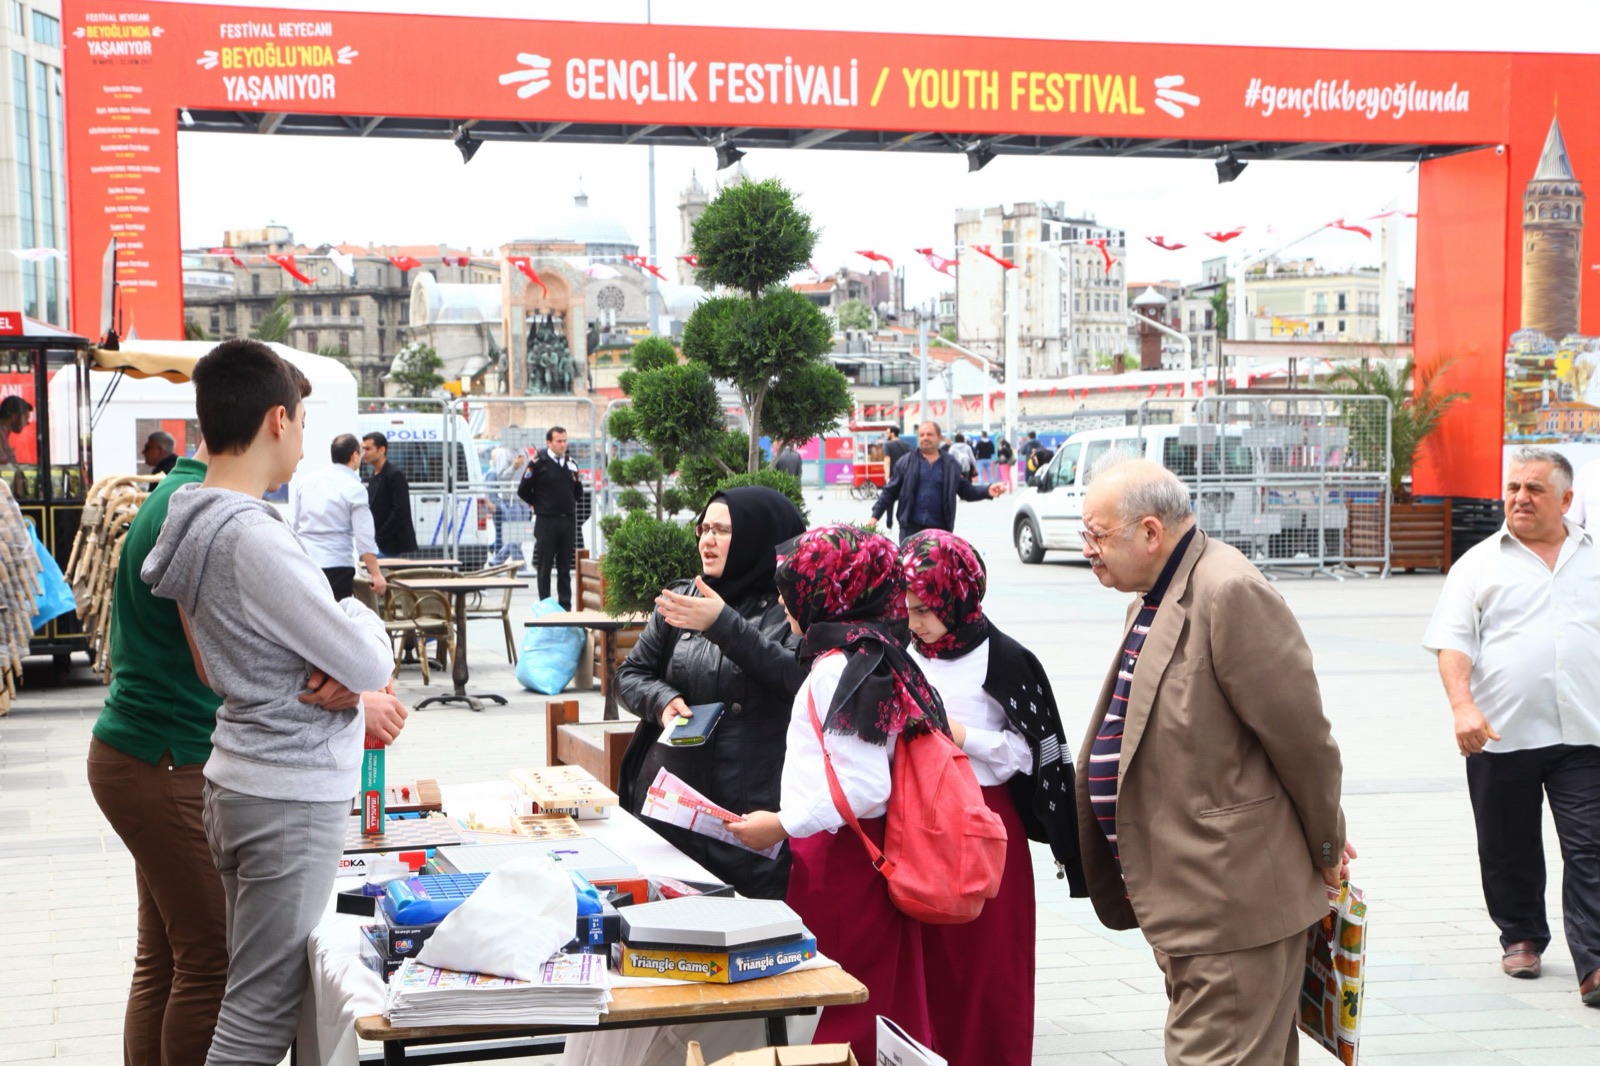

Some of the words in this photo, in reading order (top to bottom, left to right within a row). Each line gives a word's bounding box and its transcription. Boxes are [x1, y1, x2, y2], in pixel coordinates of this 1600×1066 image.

[220, 21, 275, 38] FESTİVAL
[279, 22, 332, 37] HEYECANI
[87, 40, 152, 58] YAŞANIYOR
[222, 43, 334, 69] BEYOĞLU'NDA
[223, 74, 335, 106] YAŞANIYOR
[566, 52, 698, 105] GENÇLİK
[709, 56, 858, 107] FESTİVALİ
[902, 68, 999, 110] YOUTH
[1011, 71, 1145, 115] FESTIVAL
[1244, 78, 1469, 119] #gençlikbeyoğlunda
[386, 429, 437, 440] POLİS
[630, 955, 675, 972] Triangle
[677, 959, 709, 973] Game
[737, 956, 775, 972] Triangle
[776, 952, 802, 966] Game
